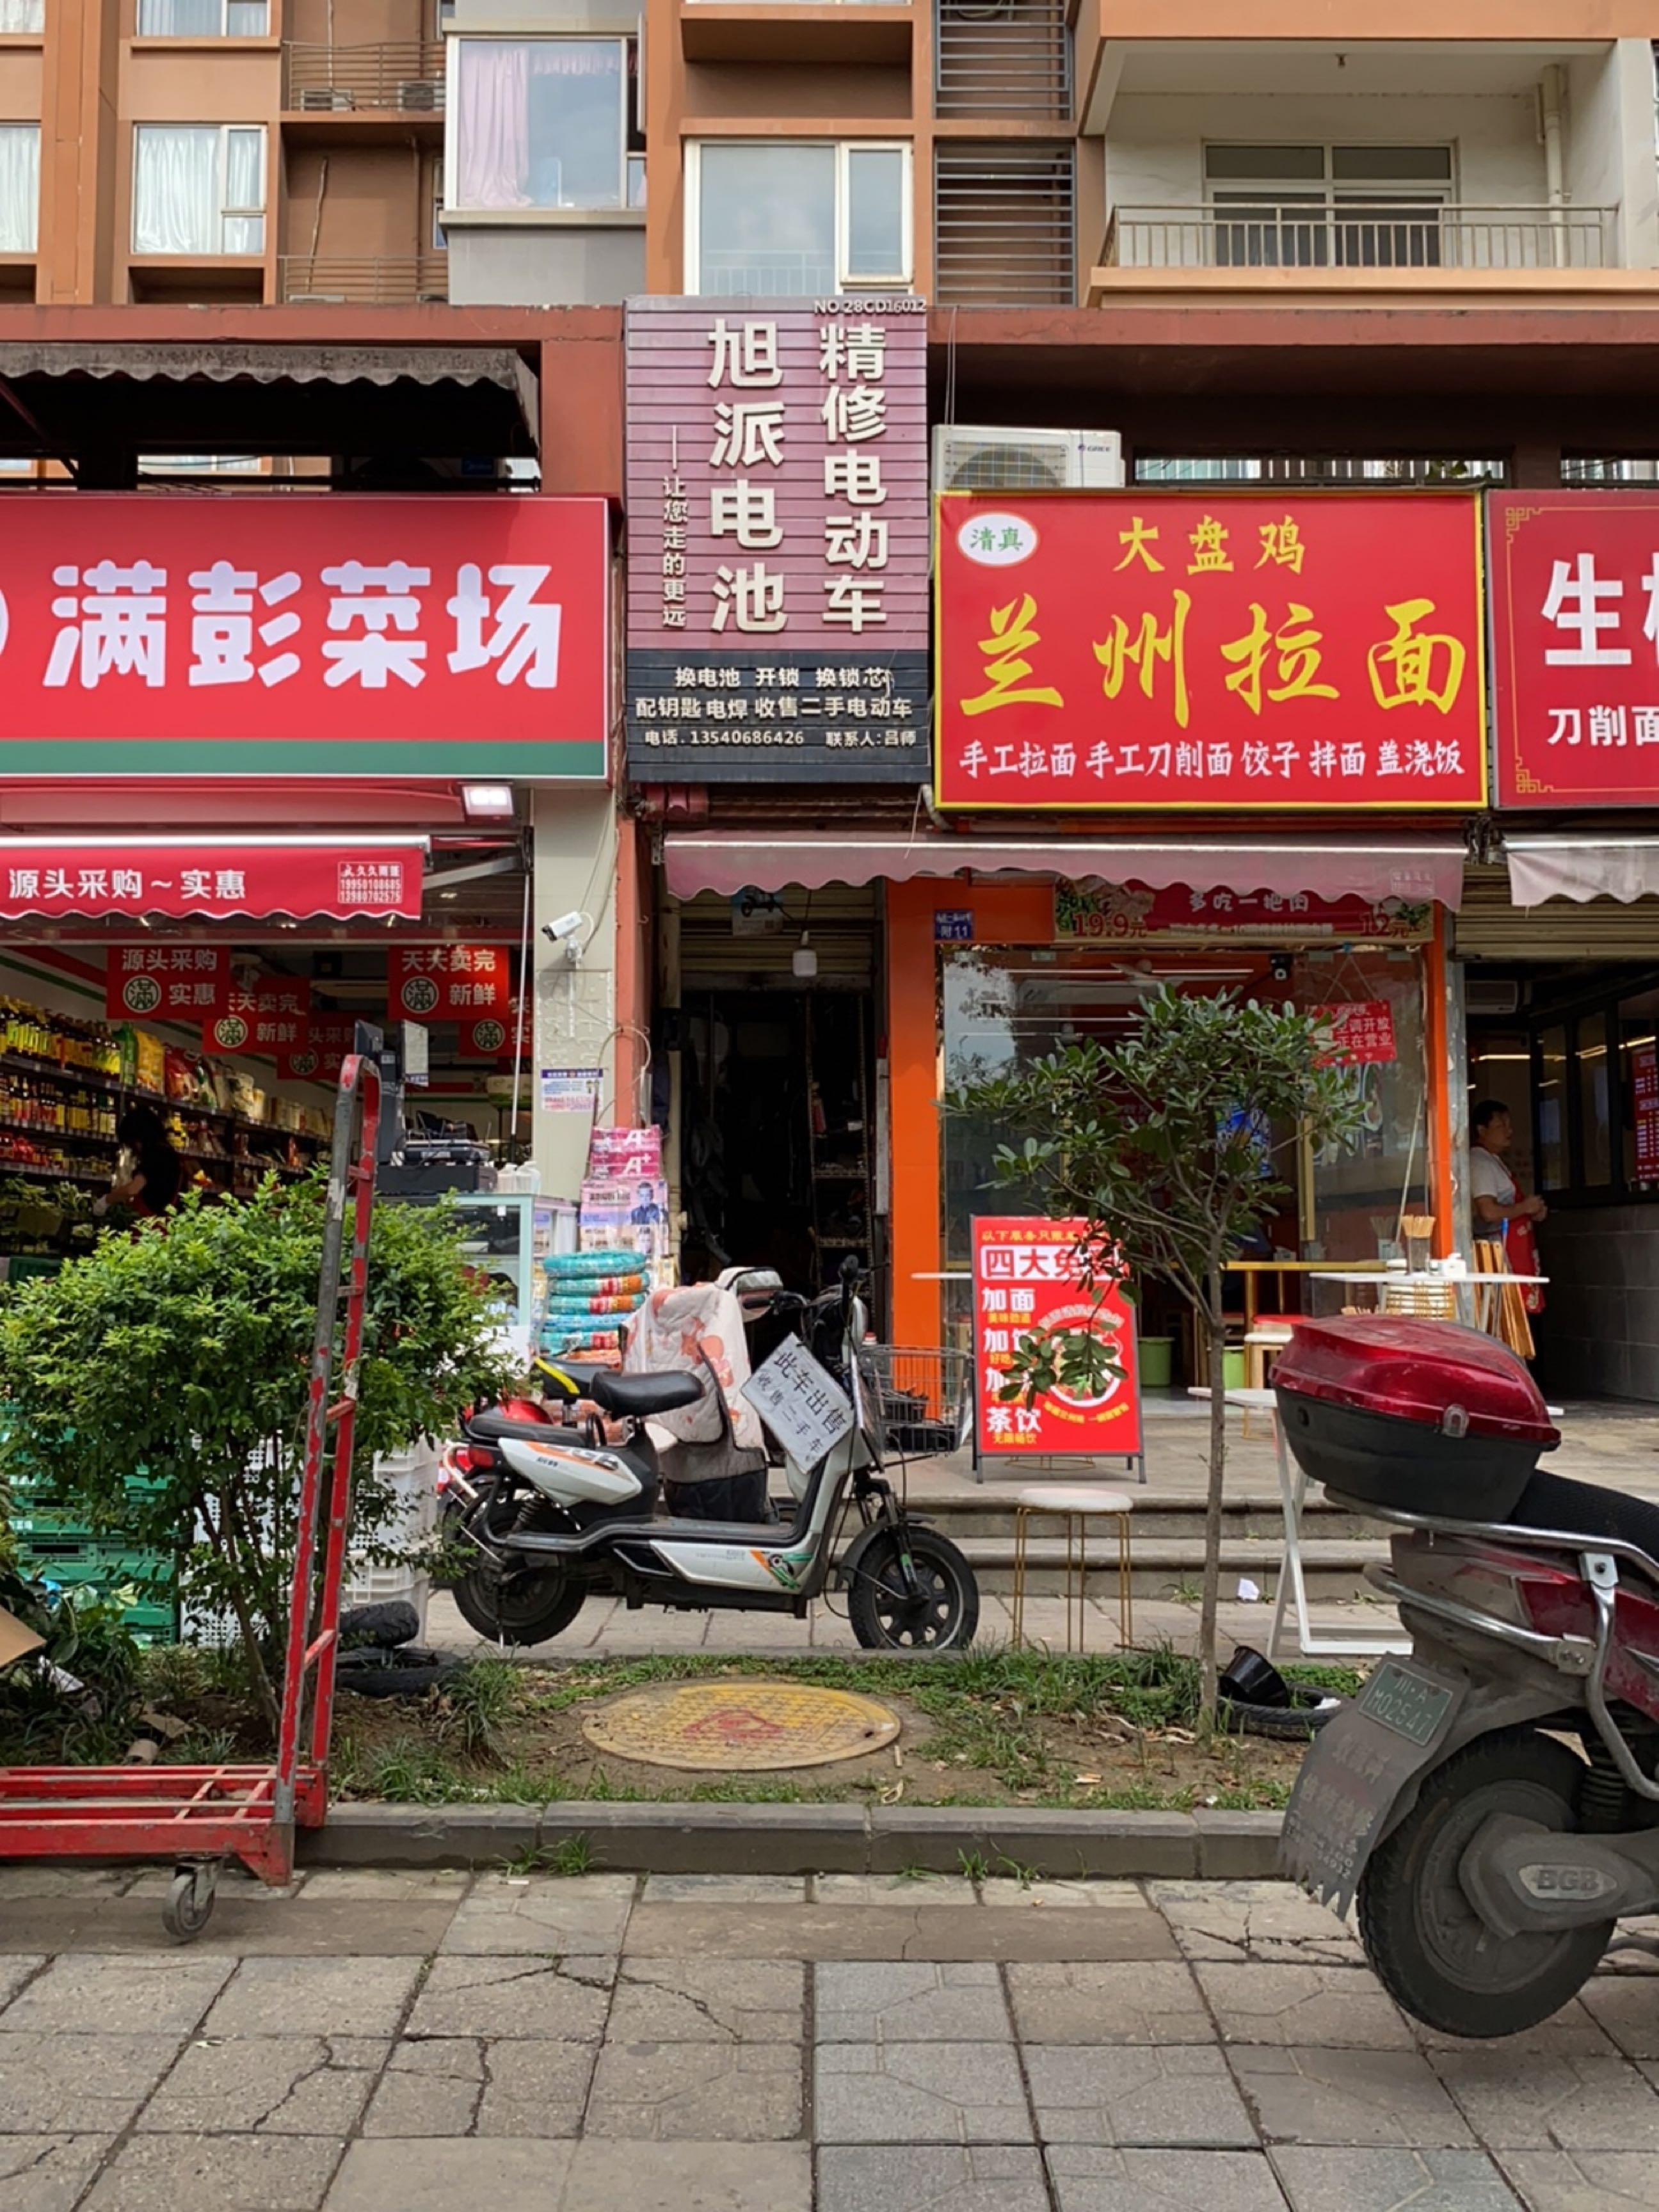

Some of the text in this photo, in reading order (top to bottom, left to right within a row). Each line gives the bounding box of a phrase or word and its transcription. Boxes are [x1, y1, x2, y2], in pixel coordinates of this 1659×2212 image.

[707, 318, 788, 633] 旭派电池
[819, 323, 888, 632] 精修电动车
[969, 525, 1024, 551] 清真
[1112, 515, 1306, 575] 大盘鸡
[43, 559, 562, 689] 满彭菜场
[960, 588, 1466, 728] 兰州拉面
[675, 667, 741, 688] 换电池
[755, 668, 799, 688] 开锁
[635, 696, 913, 720] 配钥匙 电焊 收售二手电动车
[1547, 705, 1659, 747] 刀削面
[958, 739, 1466, 778] 手工拉面 手工刀削面 饺子 拌面 盖浇饭
[122, 948, 218, 972] 源头采购
[168, 982, 216, 1006] 实惠
[228, 993, 298, 1014] 天卖完
[449, 982, 496, 1006] 新鲜
[257, 1022, 297, 1043] 新鲜
[981, 1287, 1036, 1313] 加面
[986, 1406, 1043, 1433] 茶饮
